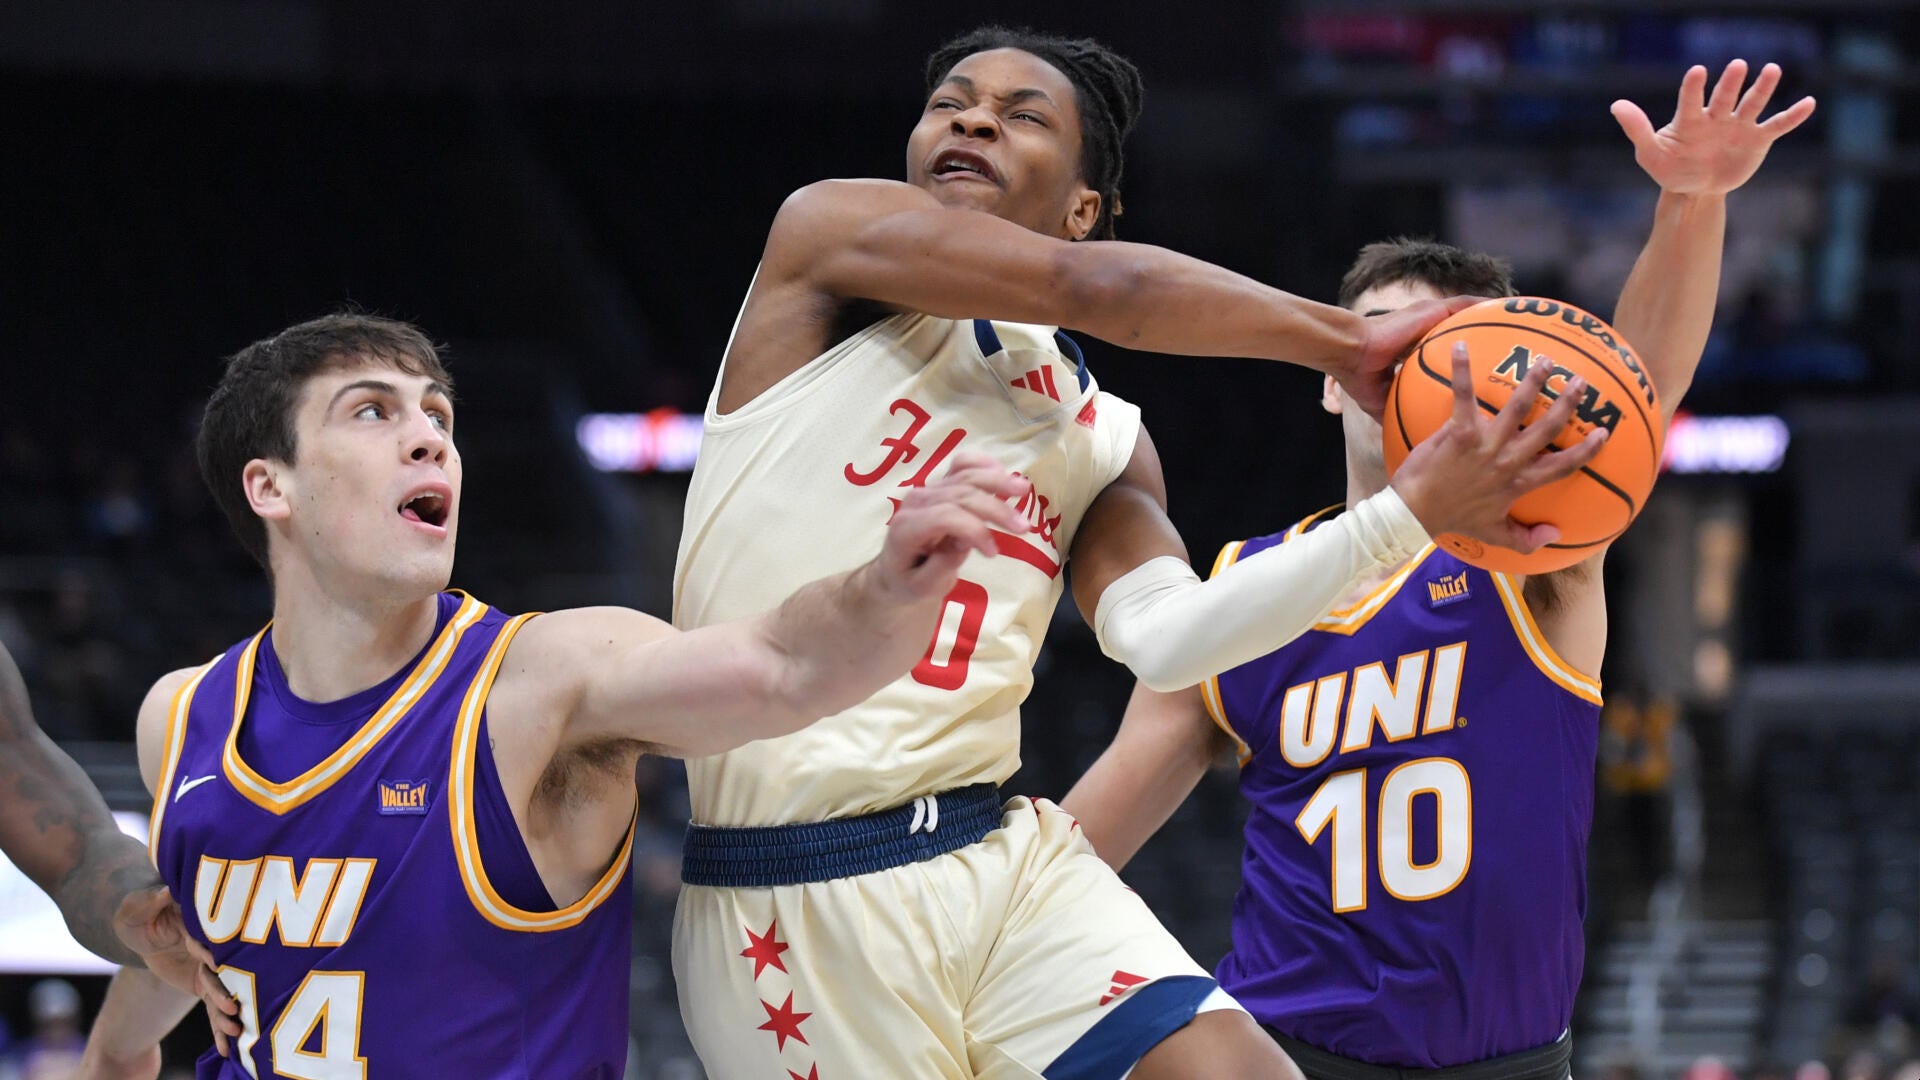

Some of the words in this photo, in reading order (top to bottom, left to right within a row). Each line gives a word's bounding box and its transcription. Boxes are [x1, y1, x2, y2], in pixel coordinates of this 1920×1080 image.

[1493, 344, 1623, 442] NCAA
[1428, 570, 1468, 601] VALLEY
[1280, 641, 1467, 768] UNI
[381, 783, 427, 807] VALLEY
[1295, 757, 1473, 914] 10
[194, 854, 377, 947] UNI
